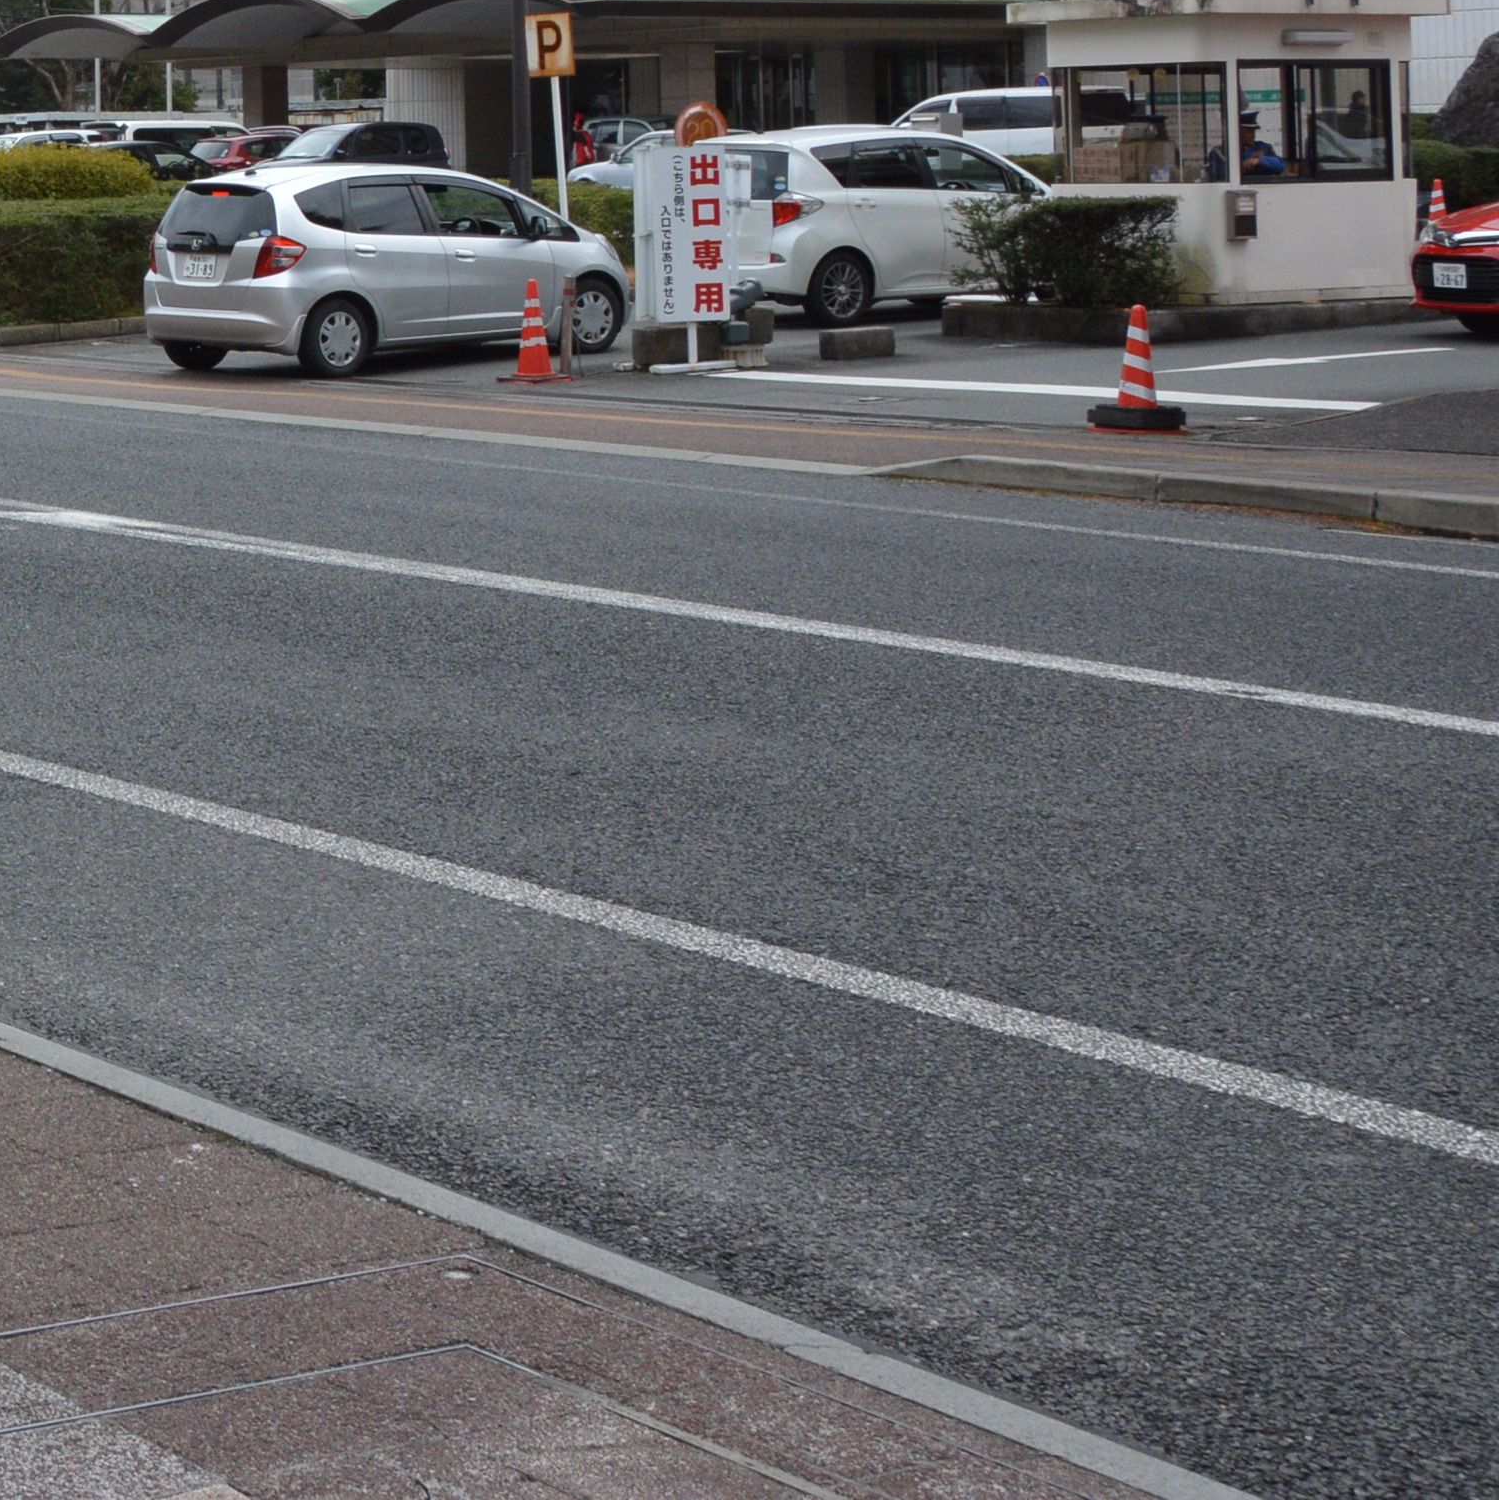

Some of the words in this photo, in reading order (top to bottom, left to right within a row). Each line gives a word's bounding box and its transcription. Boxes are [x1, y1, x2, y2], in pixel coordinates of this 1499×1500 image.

[536, 20, 562, 70] P
[689, 153, 725, 314] 出口専用
